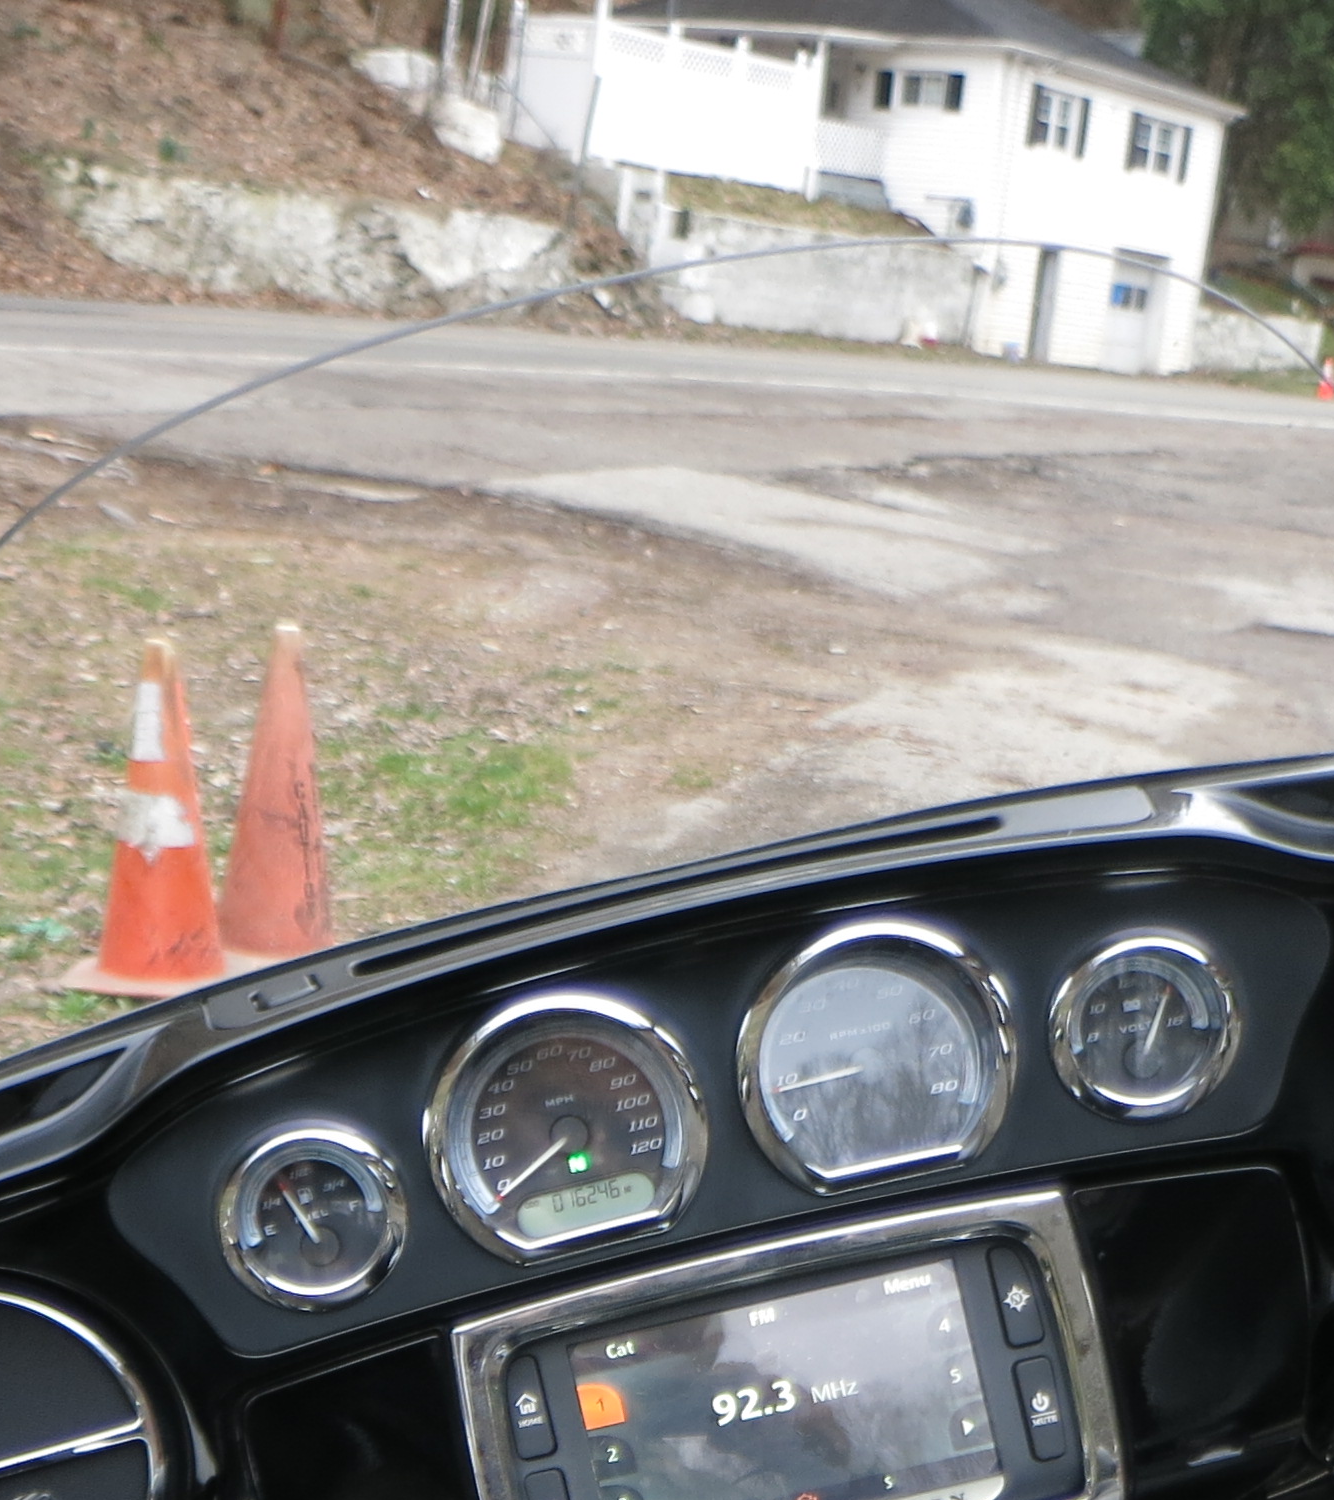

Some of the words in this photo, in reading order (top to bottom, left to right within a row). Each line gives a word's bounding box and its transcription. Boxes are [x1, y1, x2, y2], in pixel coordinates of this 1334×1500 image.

[876, 984, 903, 999] 50
[908, 1009, 936, 1025] 60
[1089, 1003, 1105, 1015] 10
[779, 1031, 806, 1046] 20
[536, 1045, 563, 1061] 60
[568, 1046, 592, 1062] 70
[928, 1043, 953, 1063] 70
[507, 1059, 533, 1076] 50
[589, 1057, 615, 1073] 80
[487, 1079, 514, 1094] 40
[609, 1073, 636, 1090] 90
[777, 1073, 798, 1087] 10
[930, 1079, 959, 1095] 80
[545, 1094, 574, 1108] MPH
[615, 1093, 650, 1112] 100
[479, 1104, 506, 1120] 30
[793, 1108, 807, 1122] 0
[629, 1116, 659, 1133] 110
[477, 1128, 504, 1145] 20
[630, 1138, 662, 1155] 120
[483, 1155, 505, 1170] 10
[497, 1177, 511, 1192] 0
[552, 1180, 620, 1213] 016246
[349, 1201, 361, 1212] F
[264, 1225, 277, 1236] E
[883, 1274, 931, 1295] Menu
[748, 1307, 776, 1327] FM
[938, 1318, 951, 1333] 4
[606, 1341, 634, 1359] Cat
[596, 1398, 605, 1412] 1
[712, 1380, 796, 1426] 92.3
[810, 1379, 859, 1404] MHz
[607, 1447, 619, 1462] 2
